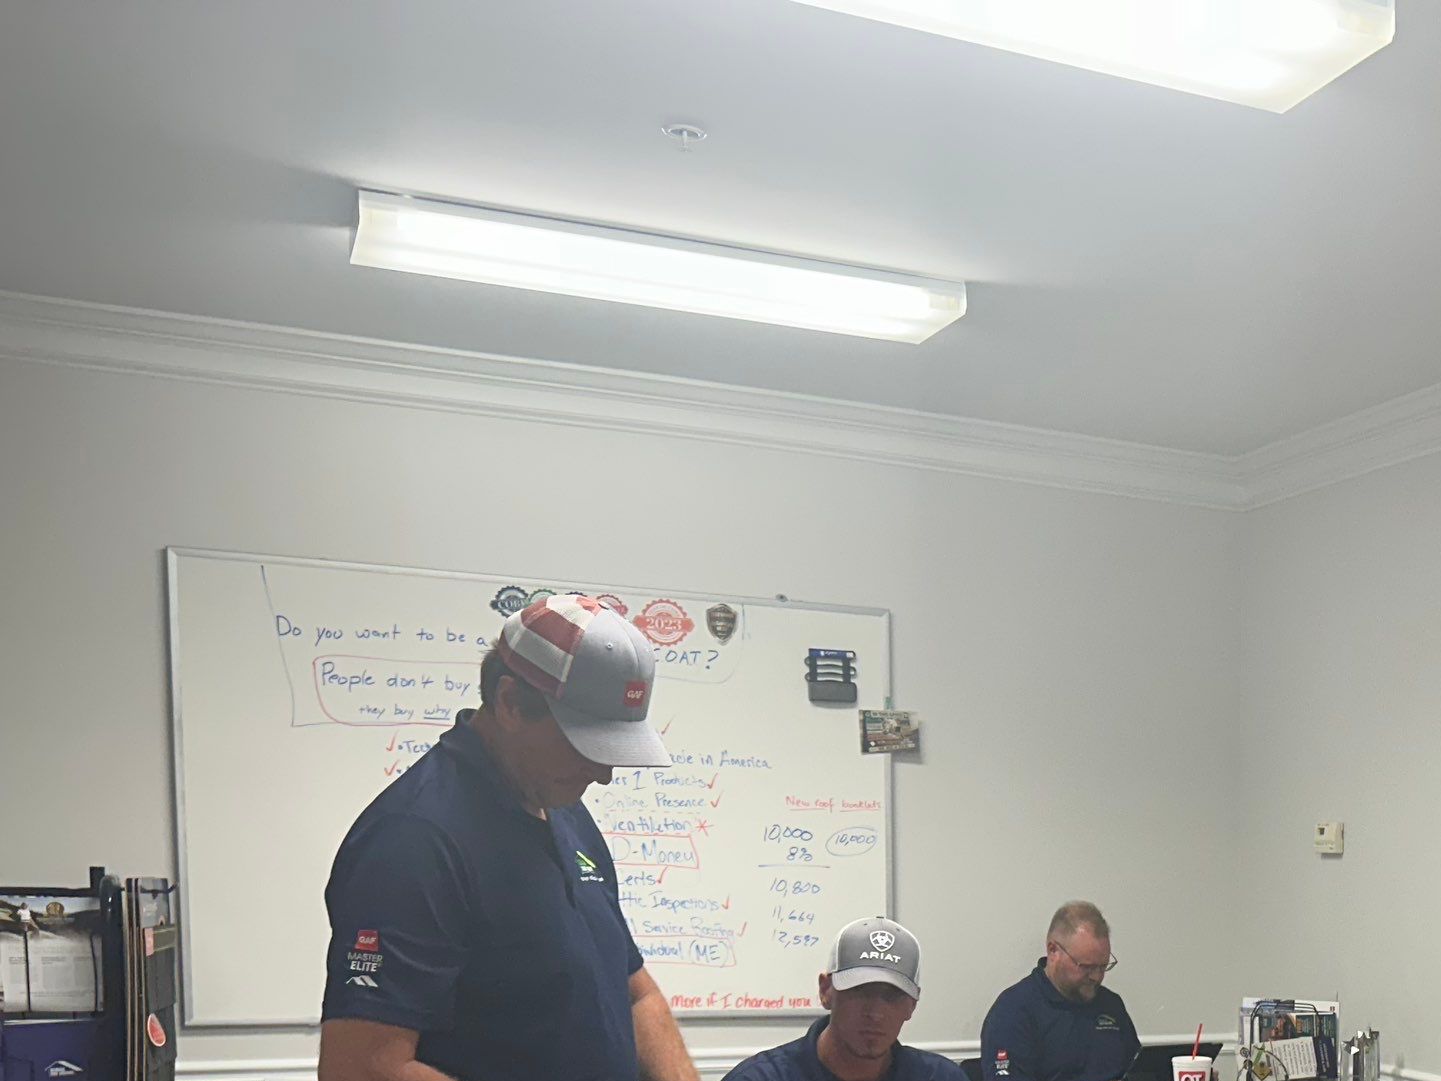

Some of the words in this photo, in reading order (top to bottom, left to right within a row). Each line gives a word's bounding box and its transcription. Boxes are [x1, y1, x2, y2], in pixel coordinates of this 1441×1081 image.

[275, 614, 302, 637] Do
[314, 627, 343, 647] you
[354, 624, 401, 642] want
[416, 626, 435, 642] to
[446, 627, 467, 643] be
[476, 636, 488, 647] a
[646, 617, 682, 631] 2023
[321, 661, 375, 693] People
[444, 680, 472, 696] buy
[627, 690, 644, 700] GAF
[394, 703, 415, 719] buy
[719, 750, 773, 769] America
[655, 792, 706, 808] Presence
[763, 823, 814, 844] 10,000
[834, 832, 877, 846] 10,000
[786, 846, 813, 862] 8%
[347, 952, 383, 962] MASTER
[859, 951, 902, 964] ARIAT
[350, 960, 378, 972] ELITE
[671, 995, 702, 1009] more
[707, 992, 718, 1008] if
[722, 993, 732, 1009] I
[735, 993, 784, 1010] charged
[788, 998, 812, 1009] you
